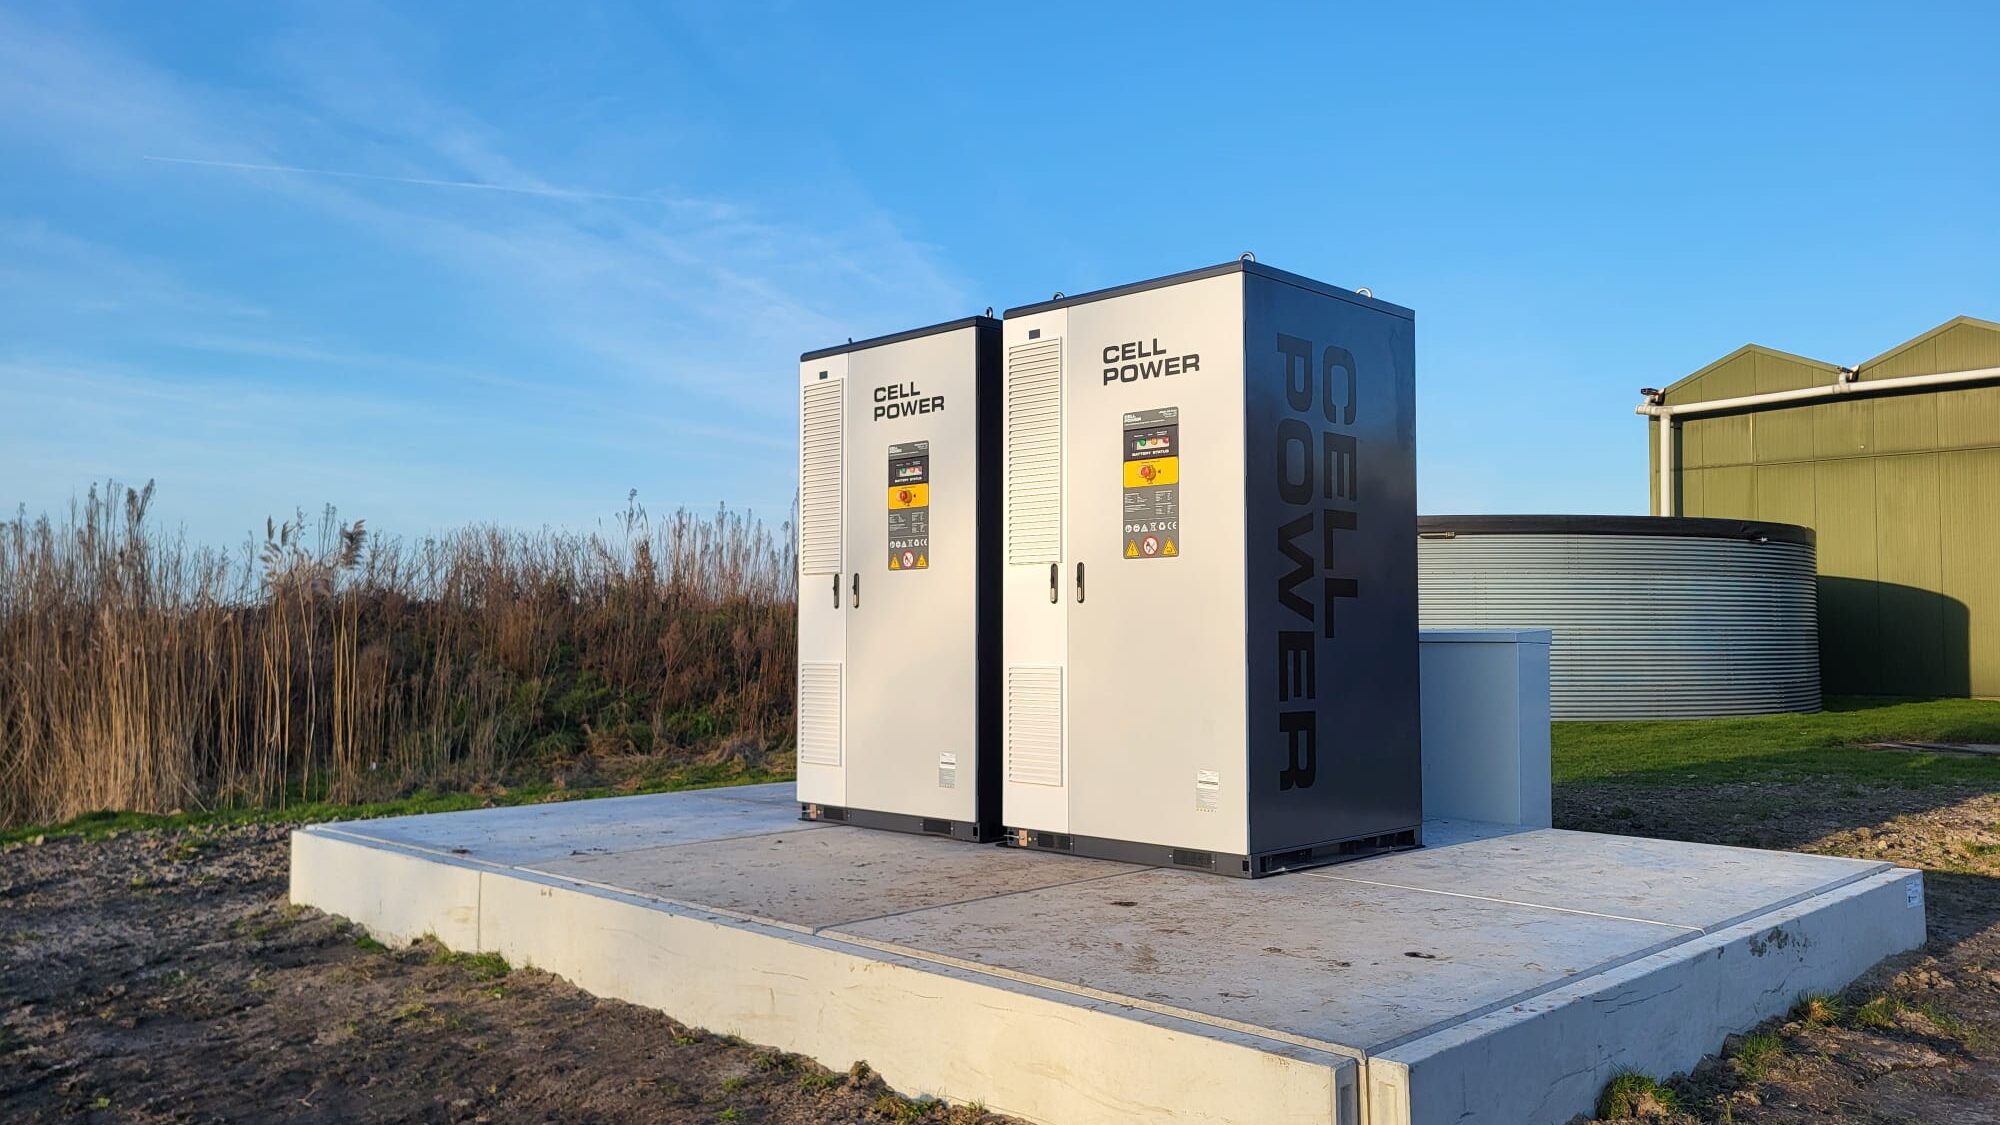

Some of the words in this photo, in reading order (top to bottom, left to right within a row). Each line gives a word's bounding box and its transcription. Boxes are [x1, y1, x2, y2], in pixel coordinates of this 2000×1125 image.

[1103, 338, 1167, 364] CELL
[1103, 354, 1200, 386] POWER
[874, 381, 921, 402] CELL
[874, 396, 945, 421] POWER
[1323, 345, 1358, 638] CELL
[1277, 332, 1316, 791] POWER
